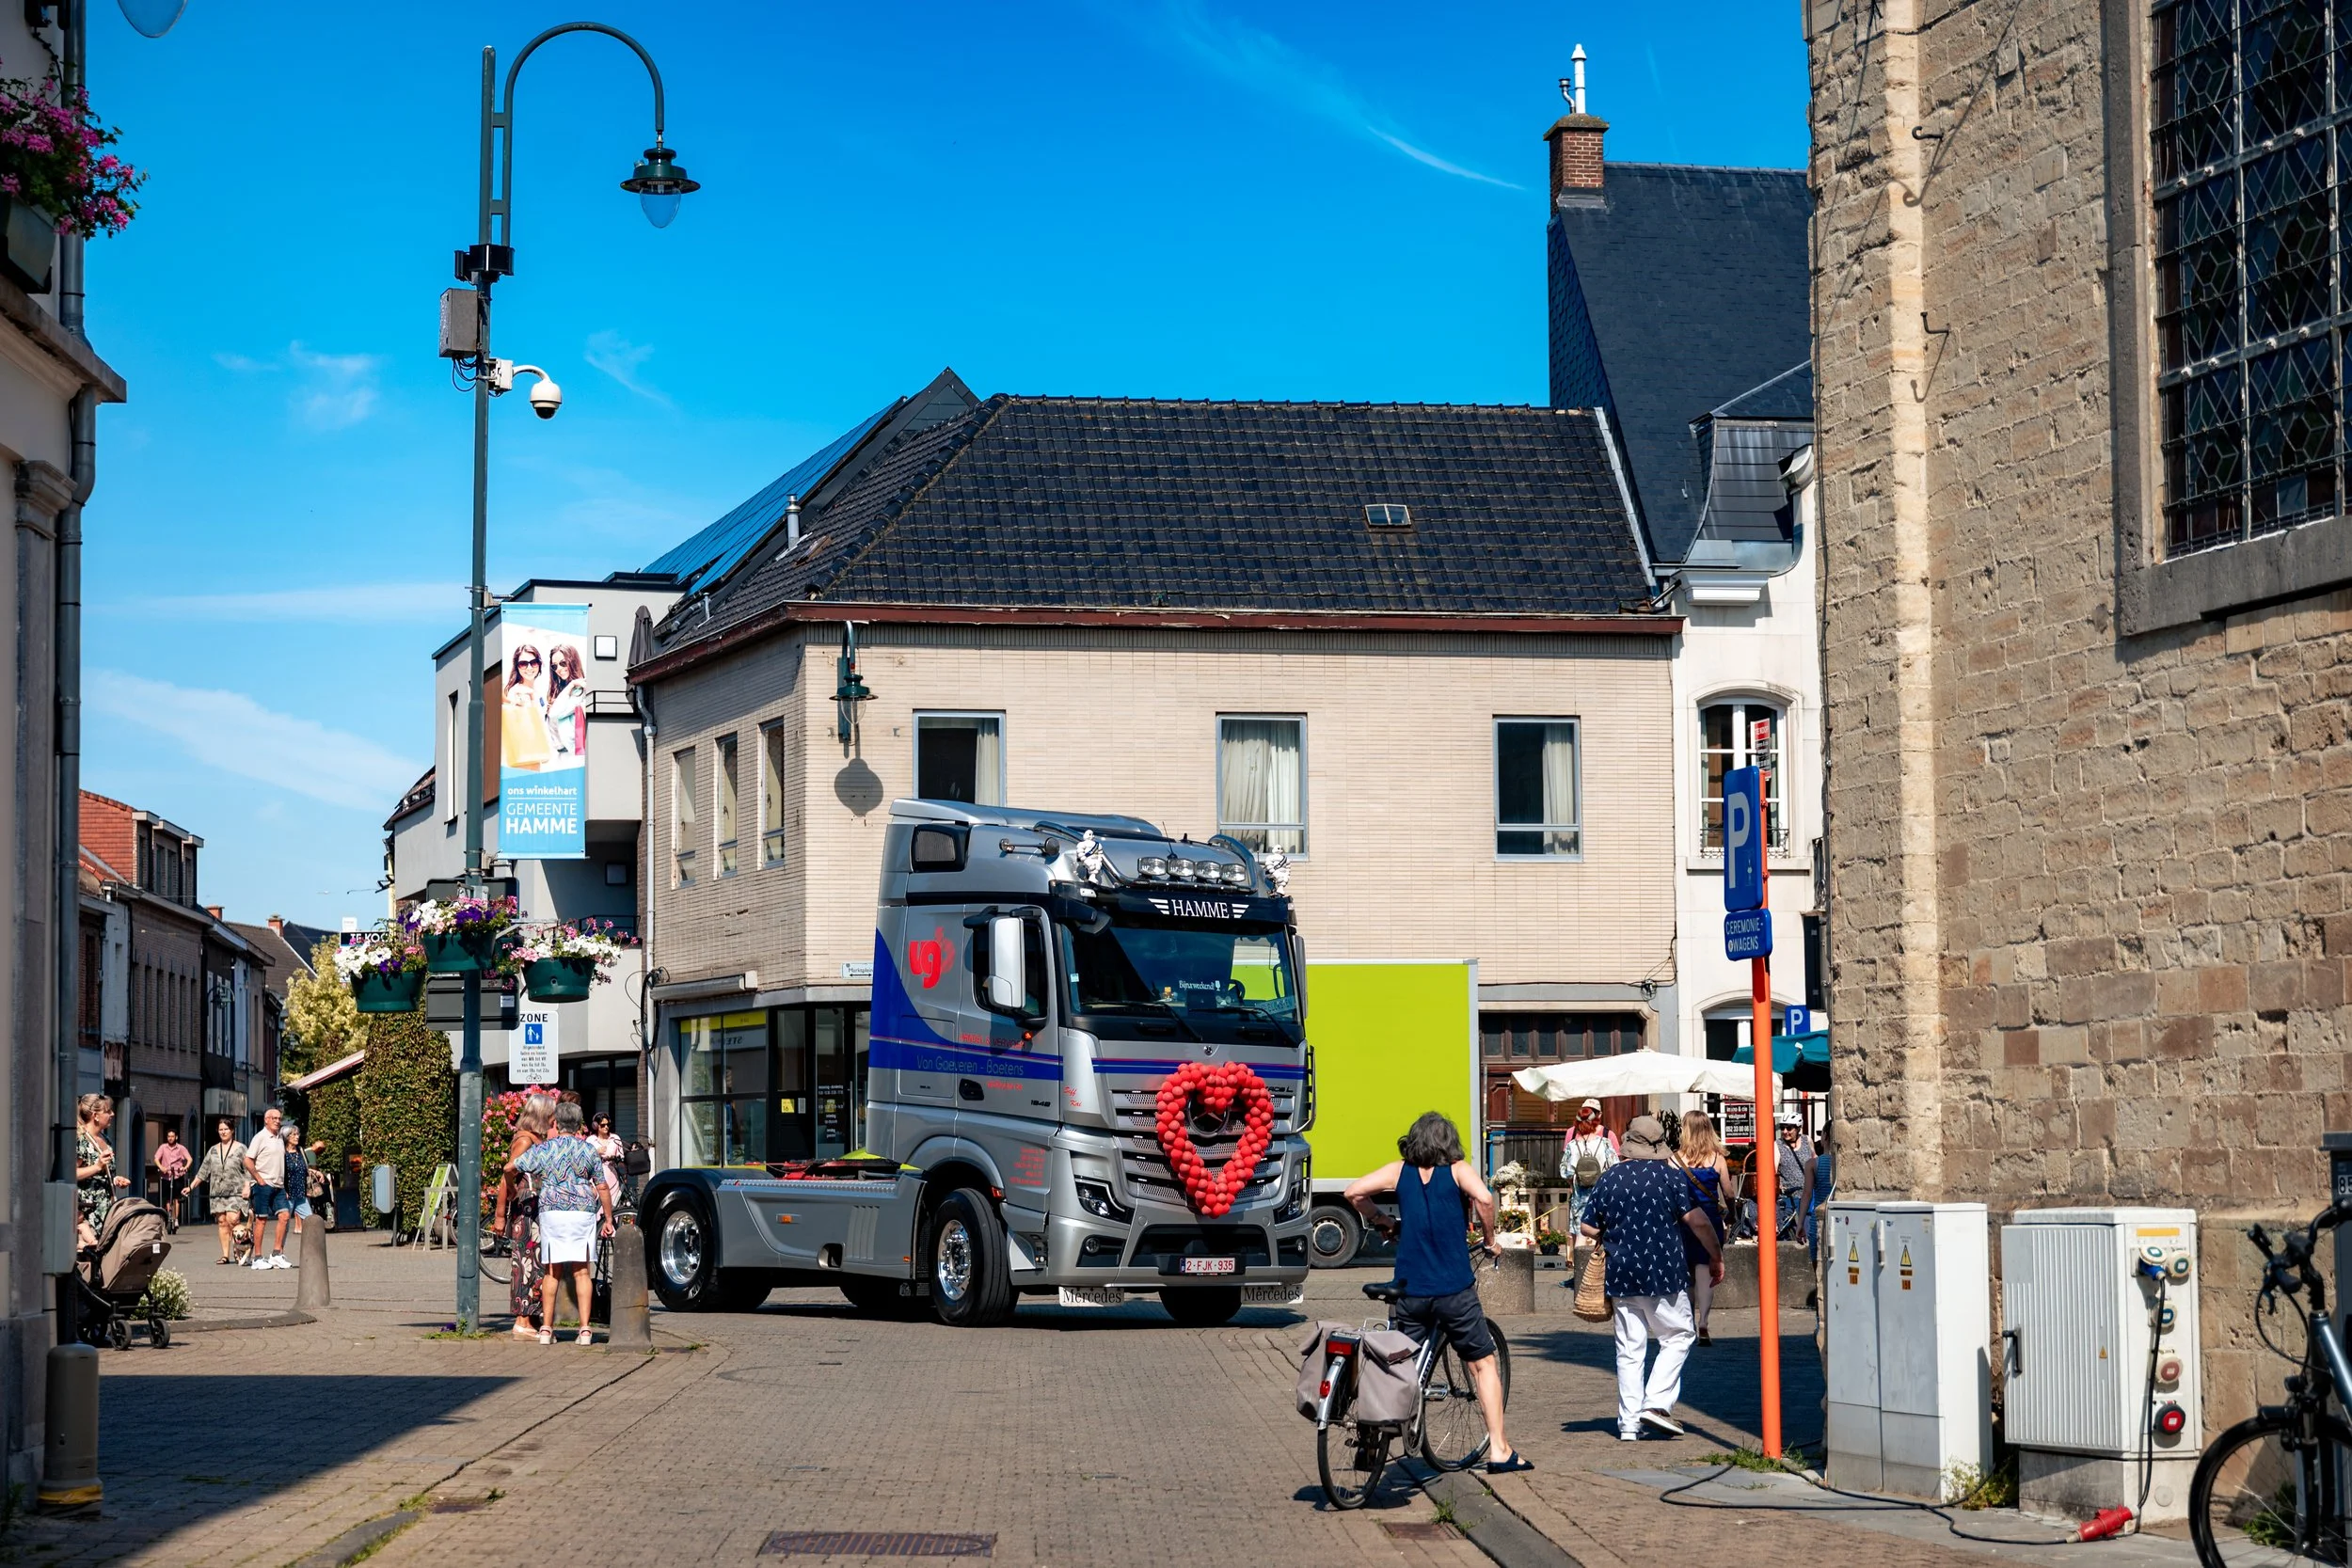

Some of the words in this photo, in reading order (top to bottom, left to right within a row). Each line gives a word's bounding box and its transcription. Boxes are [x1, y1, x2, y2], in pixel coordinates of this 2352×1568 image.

[507, 786, 524, 796] ons
[526, 784, 578, 796] winkelhart
[506, 802, 578, 816] GEMEENTE
[505, 817, 578, 834] HAMME
[1727, 791, 1751, 889] P
[1171, 899, 1230, 919] HAMME
[1733, 935, 1759, 952] WAGENS
[519, 1013, 548, 1022] ZONE
[1790, 1008, 1804, 1035] P
[916, 1055, 932, 1069] Van
[987, 1059, 1025, 1076] Baetens
[1186, 1260, 1233, 1271] 2-FJK-935
[1063, 1289, 1121, 1304] Mercedes
[1244, 1286, 1301, 1302] Mercedes
